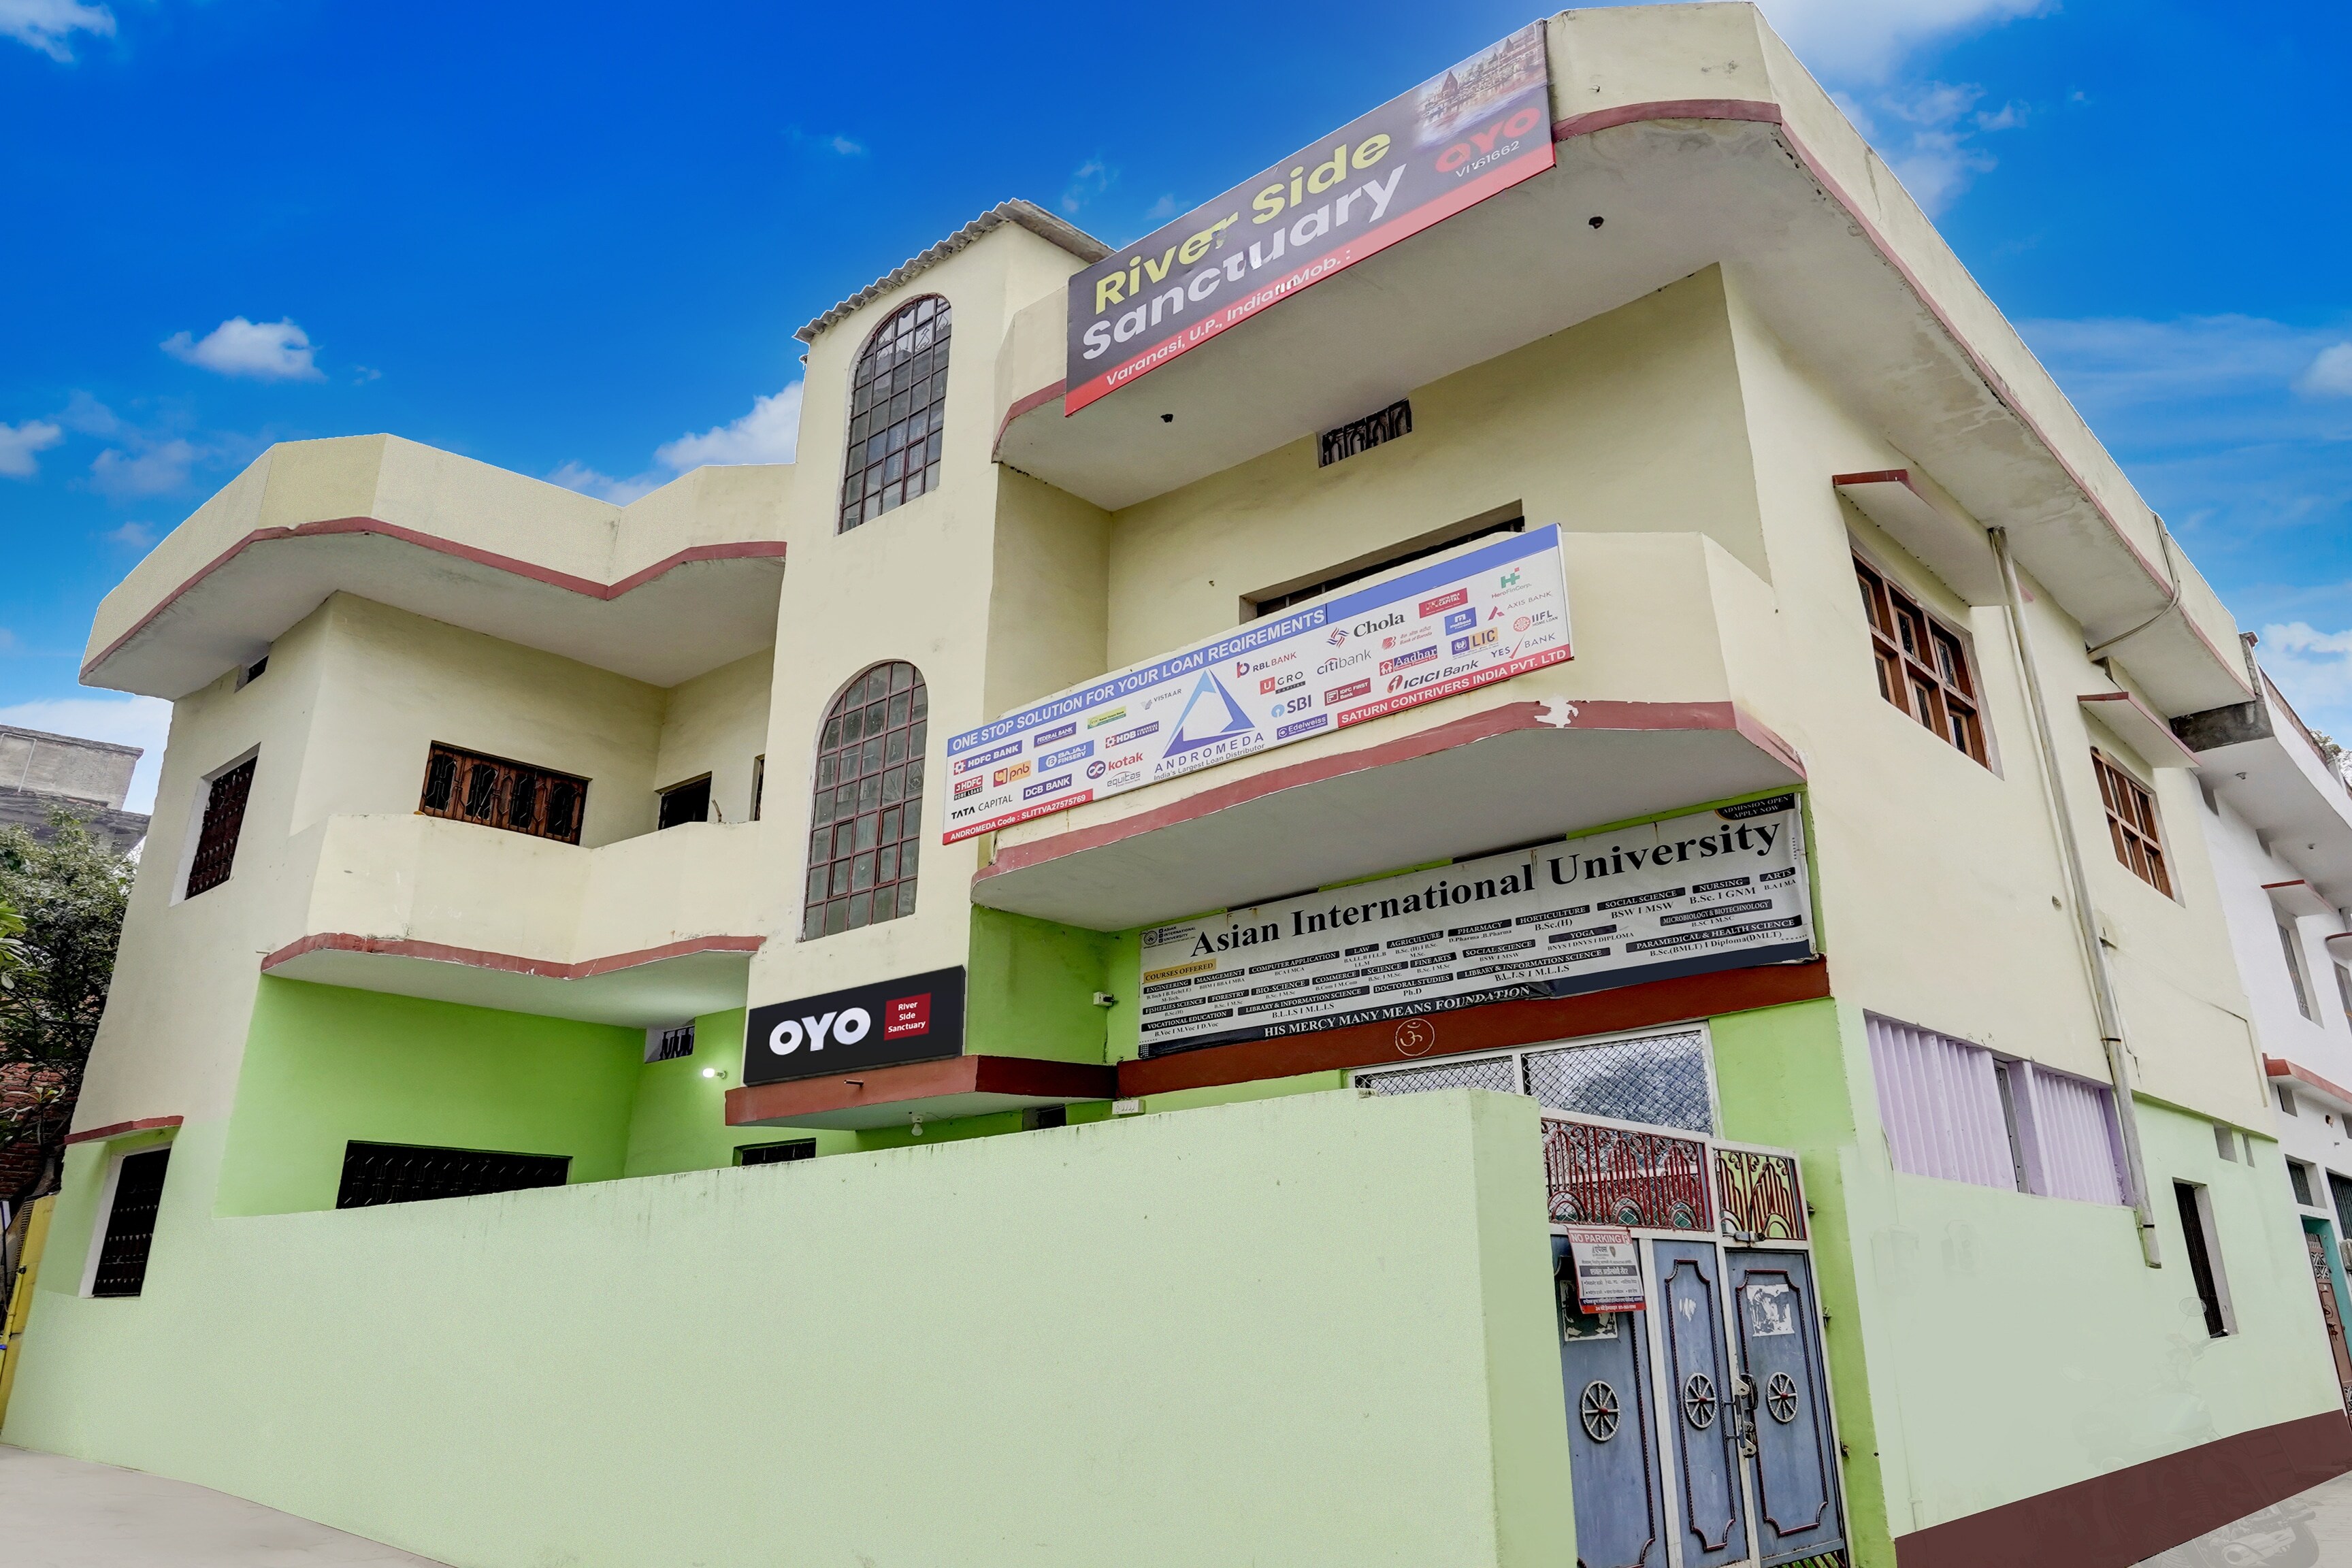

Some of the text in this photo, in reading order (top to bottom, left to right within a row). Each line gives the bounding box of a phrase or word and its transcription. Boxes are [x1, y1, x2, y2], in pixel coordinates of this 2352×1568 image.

[1435, 108, 1541, 172] OYO
[1096, 133, 1391, 314] River Side
[1082, 163, 1407, 360] Sanctuary
[1106, 336, 1186, 385] Varanasi,
[1190, 319, 1222, 341] U.P.,
[1507, 591, 1552, 610] AXIS BANK
[1354, 612, 1405, 637] Chola
[1532, 610, 1553, 623] IIFL
[1473, 630, 1494, 647] LIC
[1491, 647, 1510, 657] YES
[1524, 632, 1556, 648] BANK
[1317, 649, 1371, 674] citibank
[1395, 649, 1437, 666] Aadhar
[953, 609, 1324, 751] ONE STOP SOLUTION FOR YOUR LOAN REQIREMENTS
[1404, 670, 1440, 689] ICICI
[1443, 659, 1479, 676] Bank
[1341, 650, 1566, 723] SATURN CONTRIVERS INDIA PVT. LTD
[1154, 689, 1181, 702] VISTAAR
[1287, 695, 1311, 713] SBI
[1288, 717, 1326, 732] Edelweiss
[1037, 726, 1073, 743] FEDERAL BANK
[1116, 731, 1137, 744] HDB
[968, 744, 1019, 768] HDFC BANK
[1058, 745, 1086, 757] BAJAJ
[1058, 751, 1086, 764] FINSERV
[1155, 732, 1264, 773] ANDROMEDA
[1109, 752, 1143, 771] kotak
[1154, 744, 1264, 781] India's Largest Loan Distributor
[1010, 764, 1030, 781] pnb
[1107, 772, 1141, 788] equitas
[961, 777, 982, 791] HDFC
[1026, 777, 1071, 798] DCB BANK
[951, 795, 1013, 819] TATA CAPITAL
[1722, 800, 1766, 814] ADMISSION
[1733, 805, 1779, 819] APPLY NOW
[951, 795, 1085, 840] ANDROMEDA Code SLITTVA27575769
[1765, 869, 1791, 881] ARTS
[1190, 822, 1780, 957] Asian International University
[1699, 879, 1744, 892] NURSING
[1605, 889, 1677, 909] SOCIAL SCIENCE
[1690, 895, 1715, 904] B.Sc.
[1725, 887, 1756, 898] GNM
[1519, 906, 1586, 924] HORTICULTURE
[1612, 906, 1635, 919] BSW
[1646, 902, 1674, 913] MSW
[1663, 911, 1708, 924] MICROBIOLOGY
[1714, 902, 1769, 915] BIOTECHNOLOGY
[1458, 921, 1503, 935] PHARMACY
[1535, 918, 1573, 931] B.Sc.(H)
[1390, 932, 1441, 947] AGRICULTURE
[1570, 930, 1595, 938] YOGA
[1636, 934, 1701, 949] PARAMEDICAL
[1712, 925, 1749, 937] HEALTH
[1750, 919, 1795, 931] SCIENCE
[1711, 931, 1782, 947] Diploma(DMLT)
[1465, 941, 1532, 956] SOCIAL SCIENCE
[1252, 952, 1336, 973] COMPUTER APPLICATION
[1414, 954, 1452, 966] FINE ARTS
[1464, 966, 1495, 977] LIBRARY
[1501, 956, 1564, 970] INFORMATION
[1565, 949, 1602, 961] SCIENCE
[1145, 962, 1213, 981] COURSES OFFERED
[1196, 970, 1243, 983] MANAGEMENT
[1316, 971, 1356, 983] COMMERCE
[1367, 963, 1402, 975] SCIENCE
[1146, 980, 1189, 993] ENGINEERING
[1256, 980, 1305, 995] BIO-SCIENCE
[1375, 974, 1450, 992] DOCTORAL STUDIES
[1211, 992, 1245, 1002] FORESTRY
[1403, 988, 1422, 996] Ph.D
[898, 1001, 917, 1011] River
[1145, 998, 1204, 1014] FISHERIES SCIENCE
[1245, 1003, 1273, 1013] LIBRARY
[1281, 994, 1330, 1007] INFORMATION
[1330, 989, 1361, 1000] SCIENCE
[899, 1013, 915, 1021] Side
[1264, 985, 1531, 1037] HIS MERCY MANY MEANS FOUNDATION
[888, 1021, 926, 1033] Sanctuary
[1147, 1011, 1227, 1029] VOCATIONAL EDUCATION
[769, 1007, 871, 1056] OYO
[1571, 1233, 1621, 1243] NO PARKING
